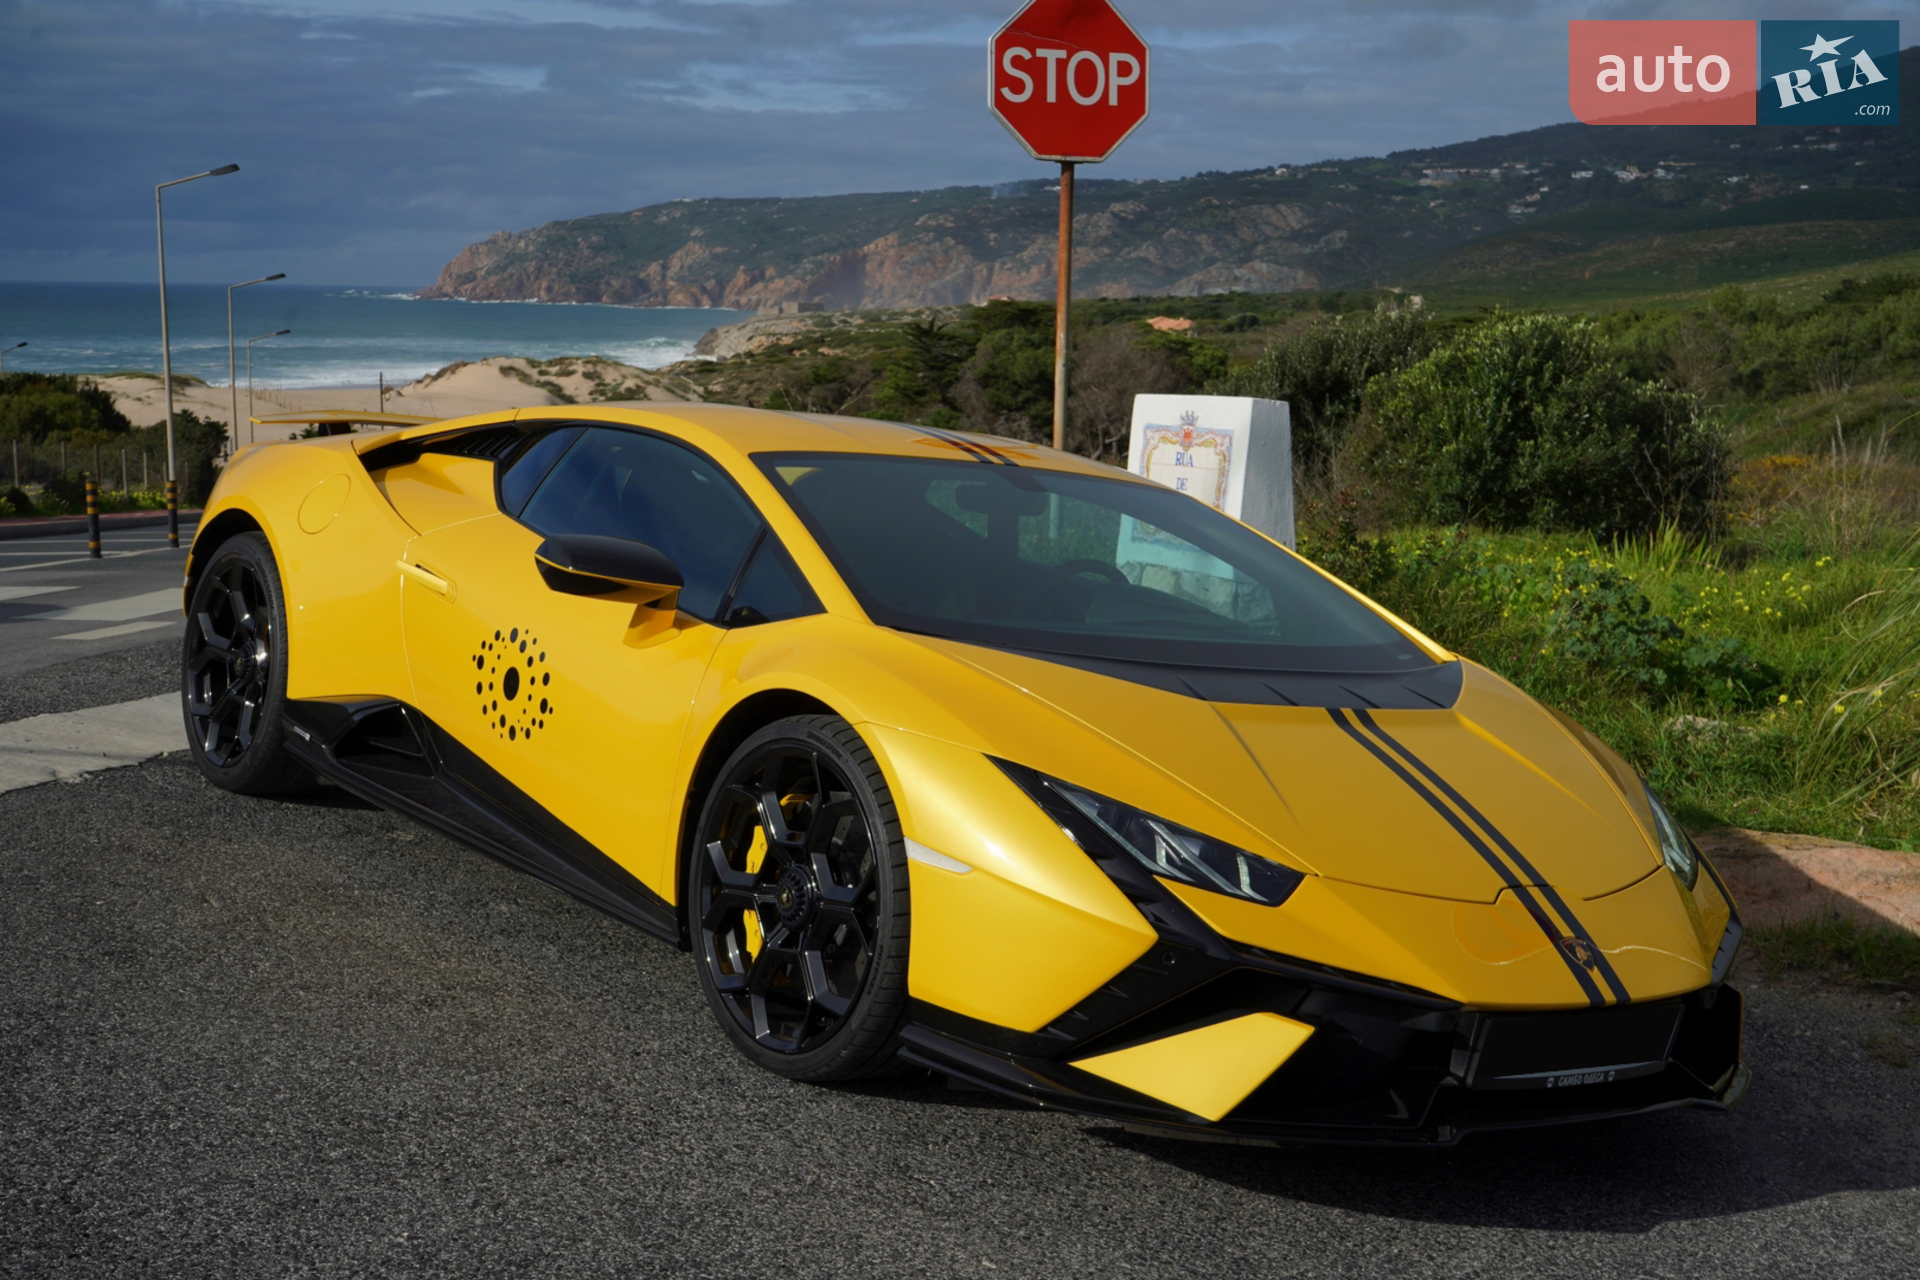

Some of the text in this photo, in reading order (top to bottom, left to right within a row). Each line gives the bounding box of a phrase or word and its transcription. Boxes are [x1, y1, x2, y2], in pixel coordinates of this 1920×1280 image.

[1000, 46, 1141, 106] STOP
[1175, 451, 1194, 468] RUA
[1176, 477, 1188, 491] DE
[806, 730, 843, 760] BRIDGESTONE
[867, 944, 884, 995] POTENZA
